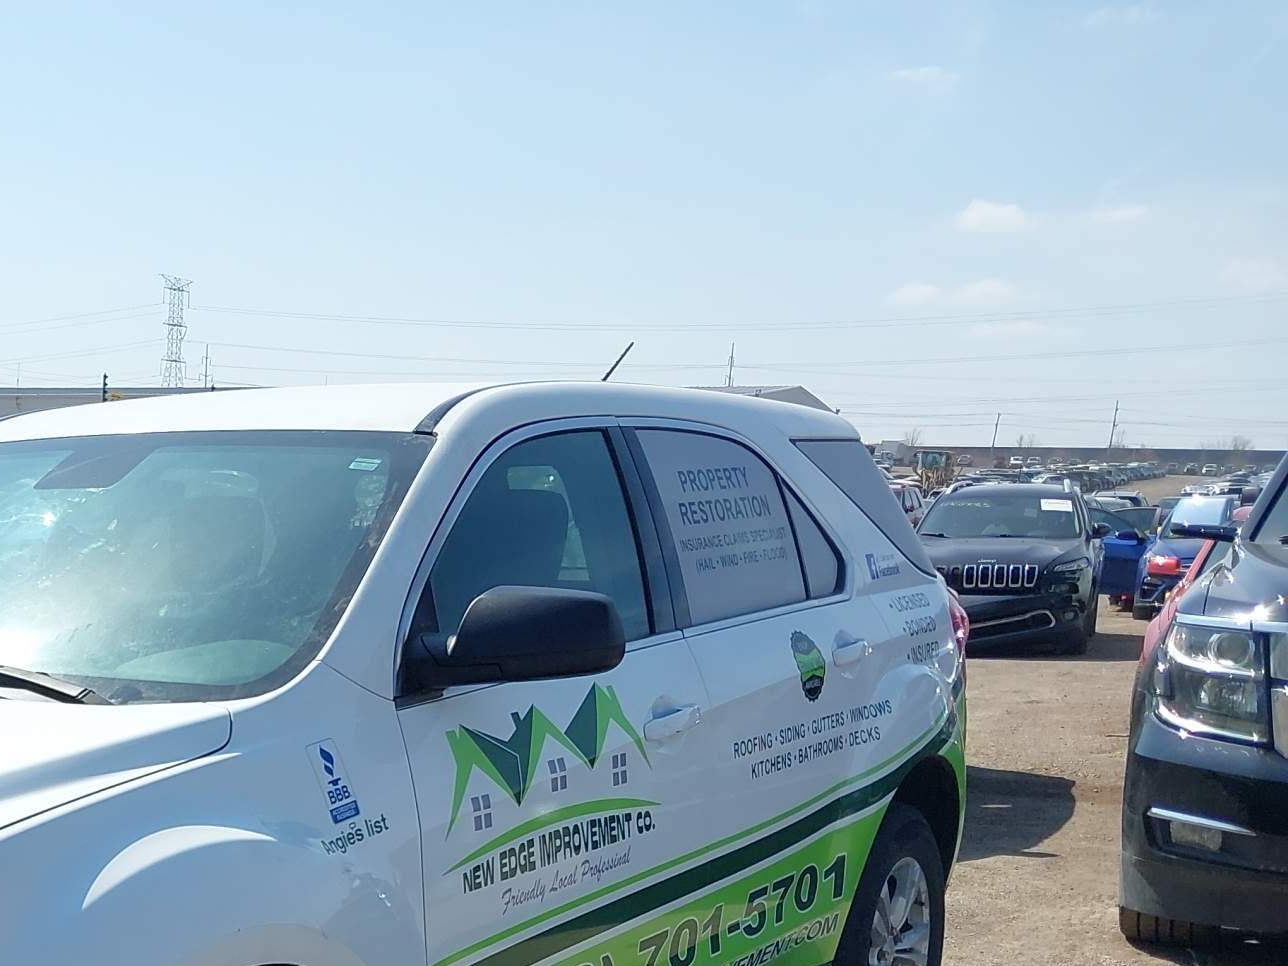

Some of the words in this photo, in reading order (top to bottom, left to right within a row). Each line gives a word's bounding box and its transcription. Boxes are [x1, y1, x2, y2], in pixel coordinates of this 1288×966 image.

[677, 466, 749, 493] PROPERTY
[678, 495, 771, 525] RESTORATION
[679, 535, 724, 552] INSURANCE
[910, 641, 940, 664] INSURED
[733, 733, 773, 759] ROOFING
[779, 723, 806, 745] SIDING
[812, 712, 845, 735] GUTTERS
[849, 700, 893, 722] WINDOWS
[751, 751, 792, 779] KITCHENS
[798, 735, 843, 764] BATHROOMS
[849, 726, 881, 747] DECKS
[327, 785, 351, 804] BBB
[364, 813, 389, 837] list
[462, 856, 494, 894] NEW
[499, 838, 537, 881] EDGE
[538, 812, 632, 868] IMPROVEMENT
[636, 810, 656, 834] CO.
[501, 878, 546, 915] Friendly
[549, 869, 577, 893] Local
